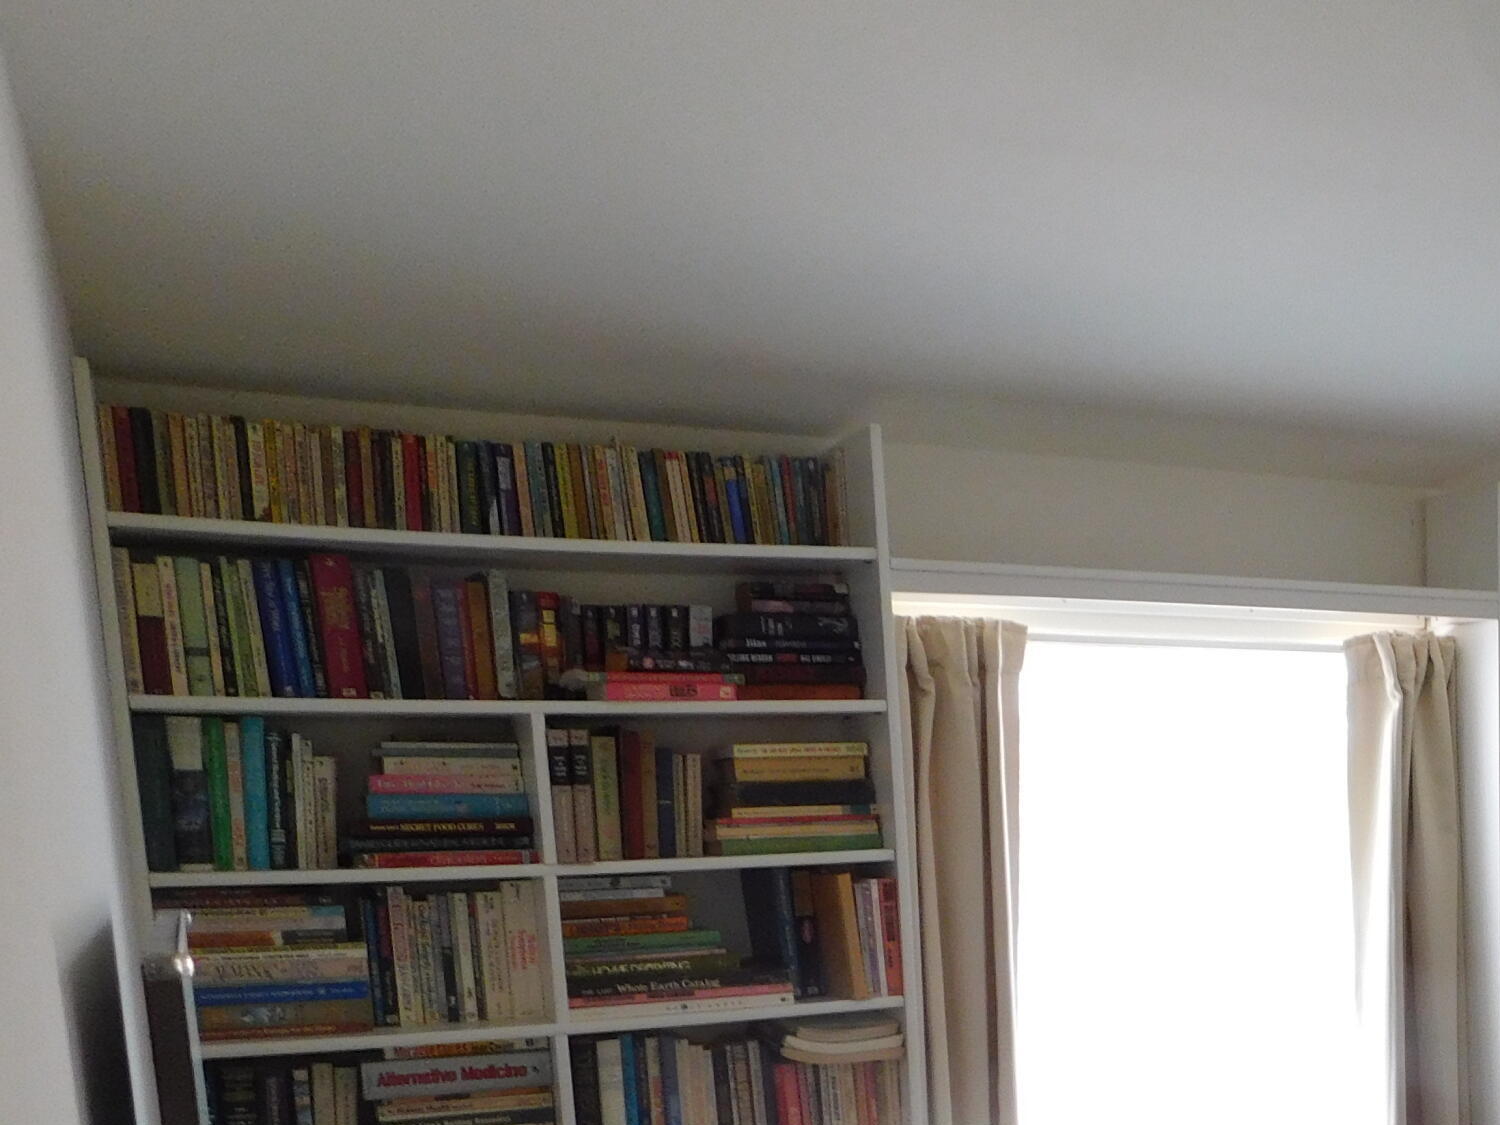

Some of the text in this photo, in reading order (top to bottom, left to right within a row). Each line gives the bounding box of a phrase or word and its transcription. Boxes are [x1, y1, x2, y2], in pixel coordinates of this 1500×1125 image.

[650, 980, 680, 991] Earth
[377, 1063, 528, 1087] Alternative Medicine
